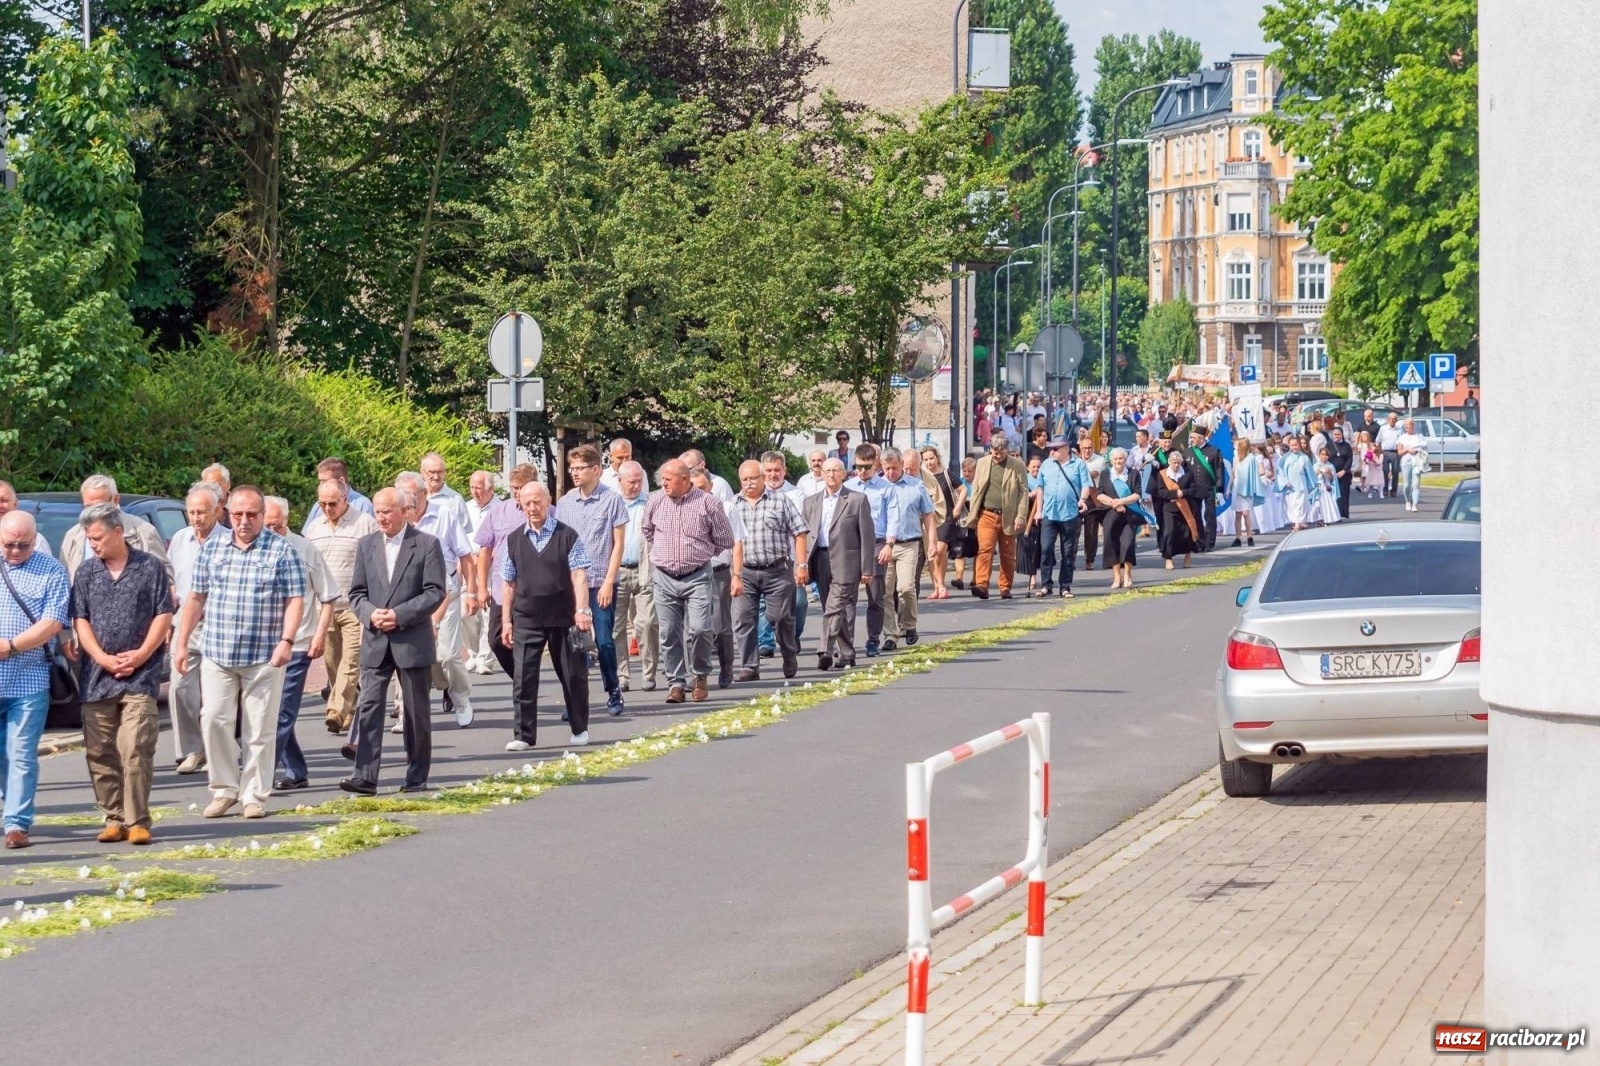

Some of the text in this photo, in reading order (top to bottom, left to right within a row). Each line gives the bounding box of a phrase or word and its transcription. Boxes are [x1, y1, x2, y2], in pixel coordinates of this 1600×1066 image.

[1435, 357, 1450, 377] P
[1333, 653, 1414, 671] SRC KY75
